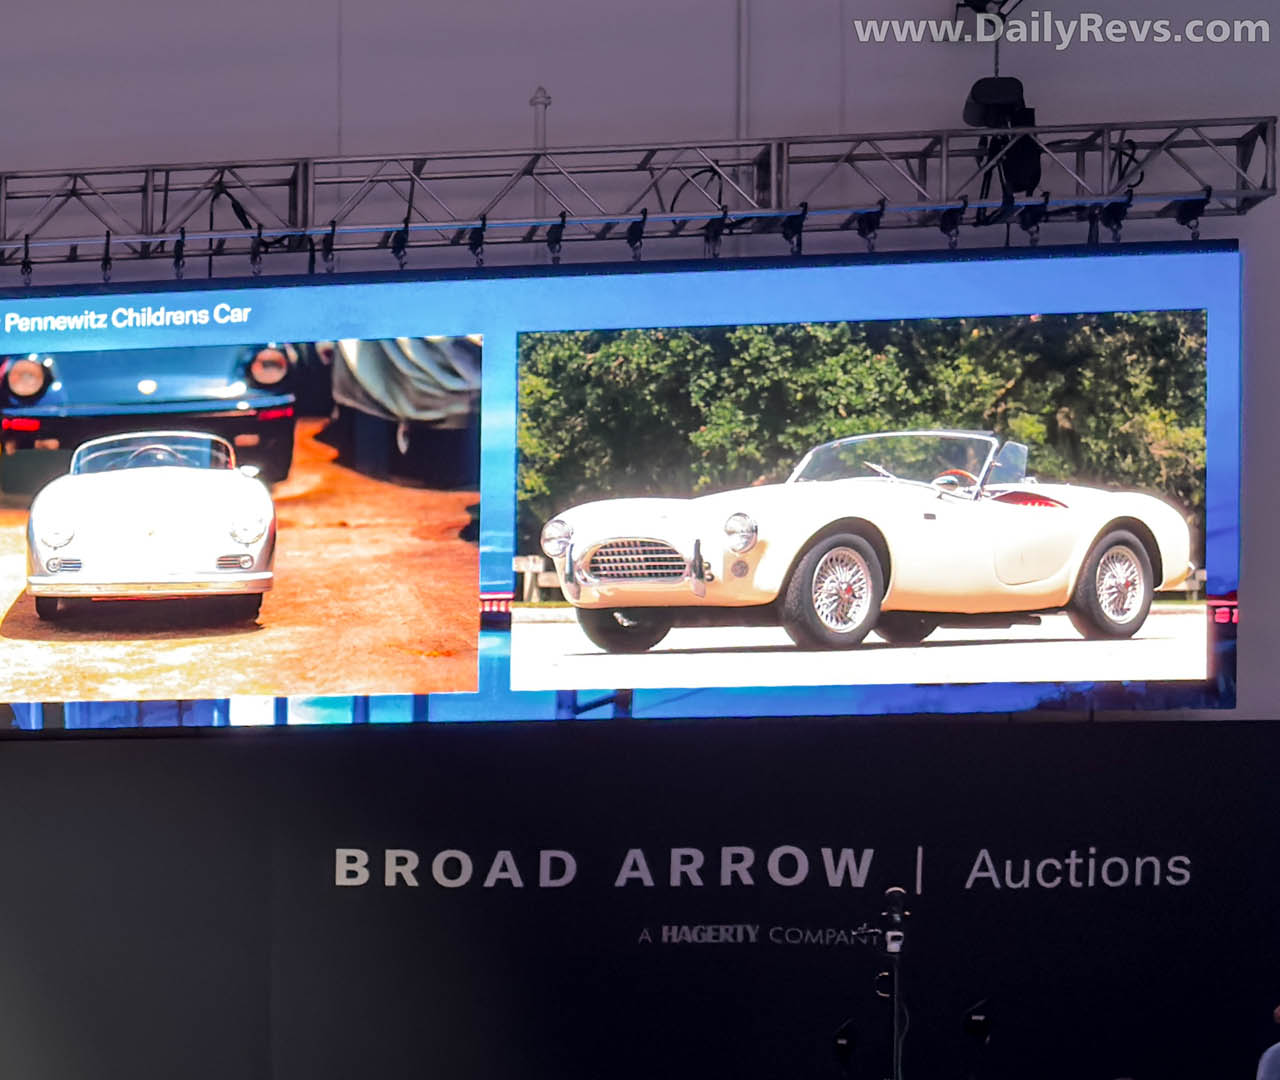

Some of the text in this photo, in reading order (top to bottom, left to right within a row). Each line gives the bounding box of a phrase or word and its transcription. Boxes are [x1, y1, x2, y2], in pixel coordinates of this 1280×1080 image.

[4, 310, 108, 333] Pennewitz
[111, 306, 209, 329] Childrens
[213, 303, 252, 324] Car
[335, 845, 1191, 889] BROAD ARROW Auctions
[638, 928, 652, 943] A
[661, 924, 760, 943] HAGERTY
